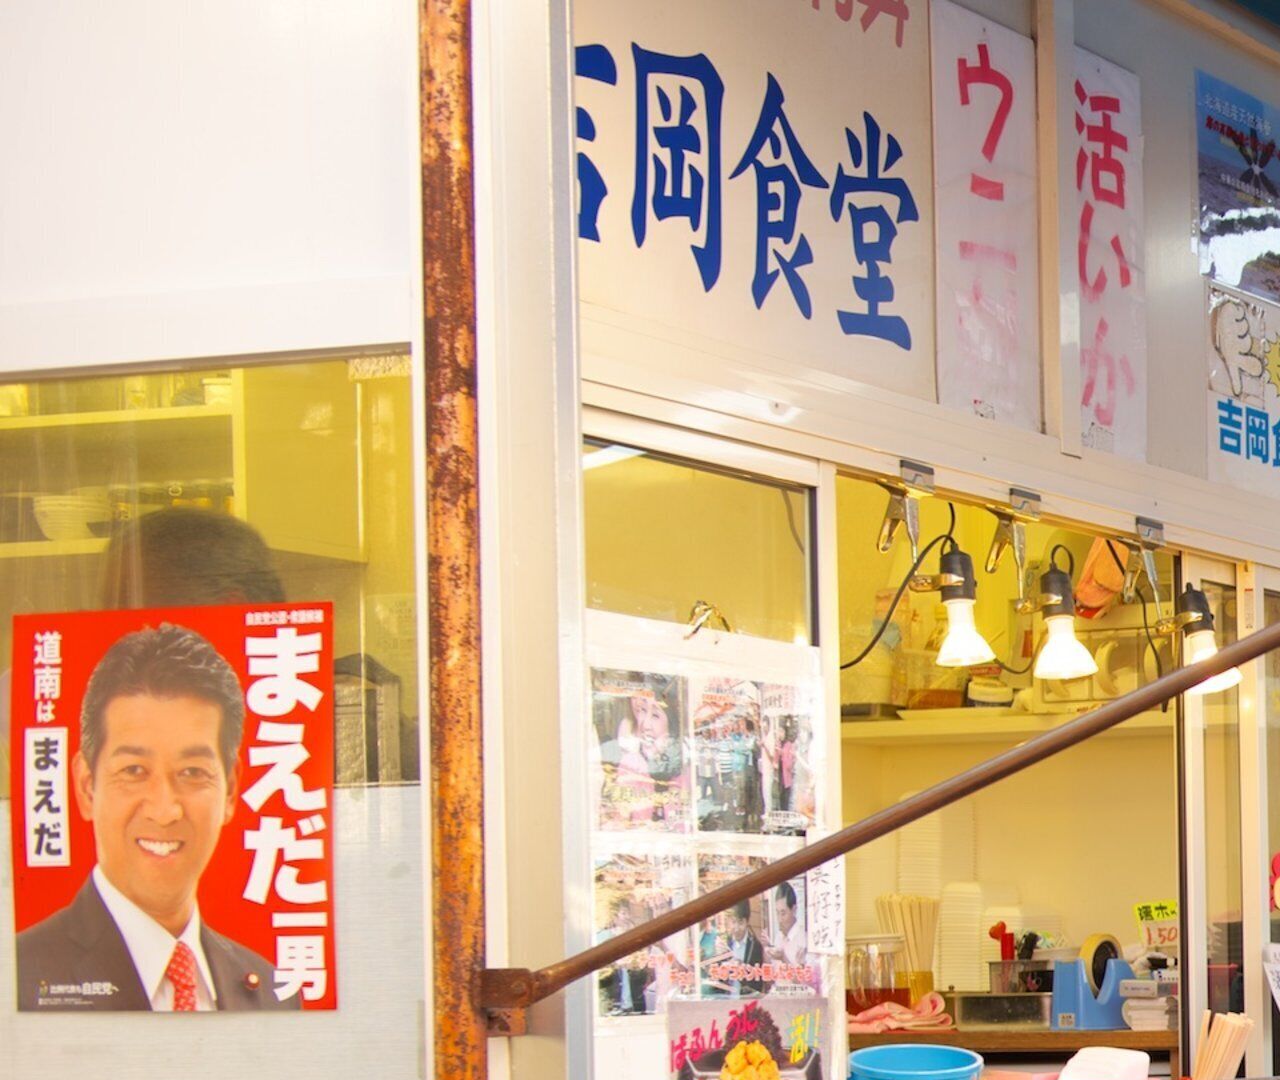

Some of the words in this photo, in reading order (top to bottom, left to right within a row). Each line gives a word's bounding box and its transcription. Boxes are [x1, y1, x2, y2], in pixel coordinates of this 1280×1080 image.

[1074, 79, 1137, 428] 活いか
[33, 631, 62, 723] 道南は
[33, 737, 62, 857] まえだ
